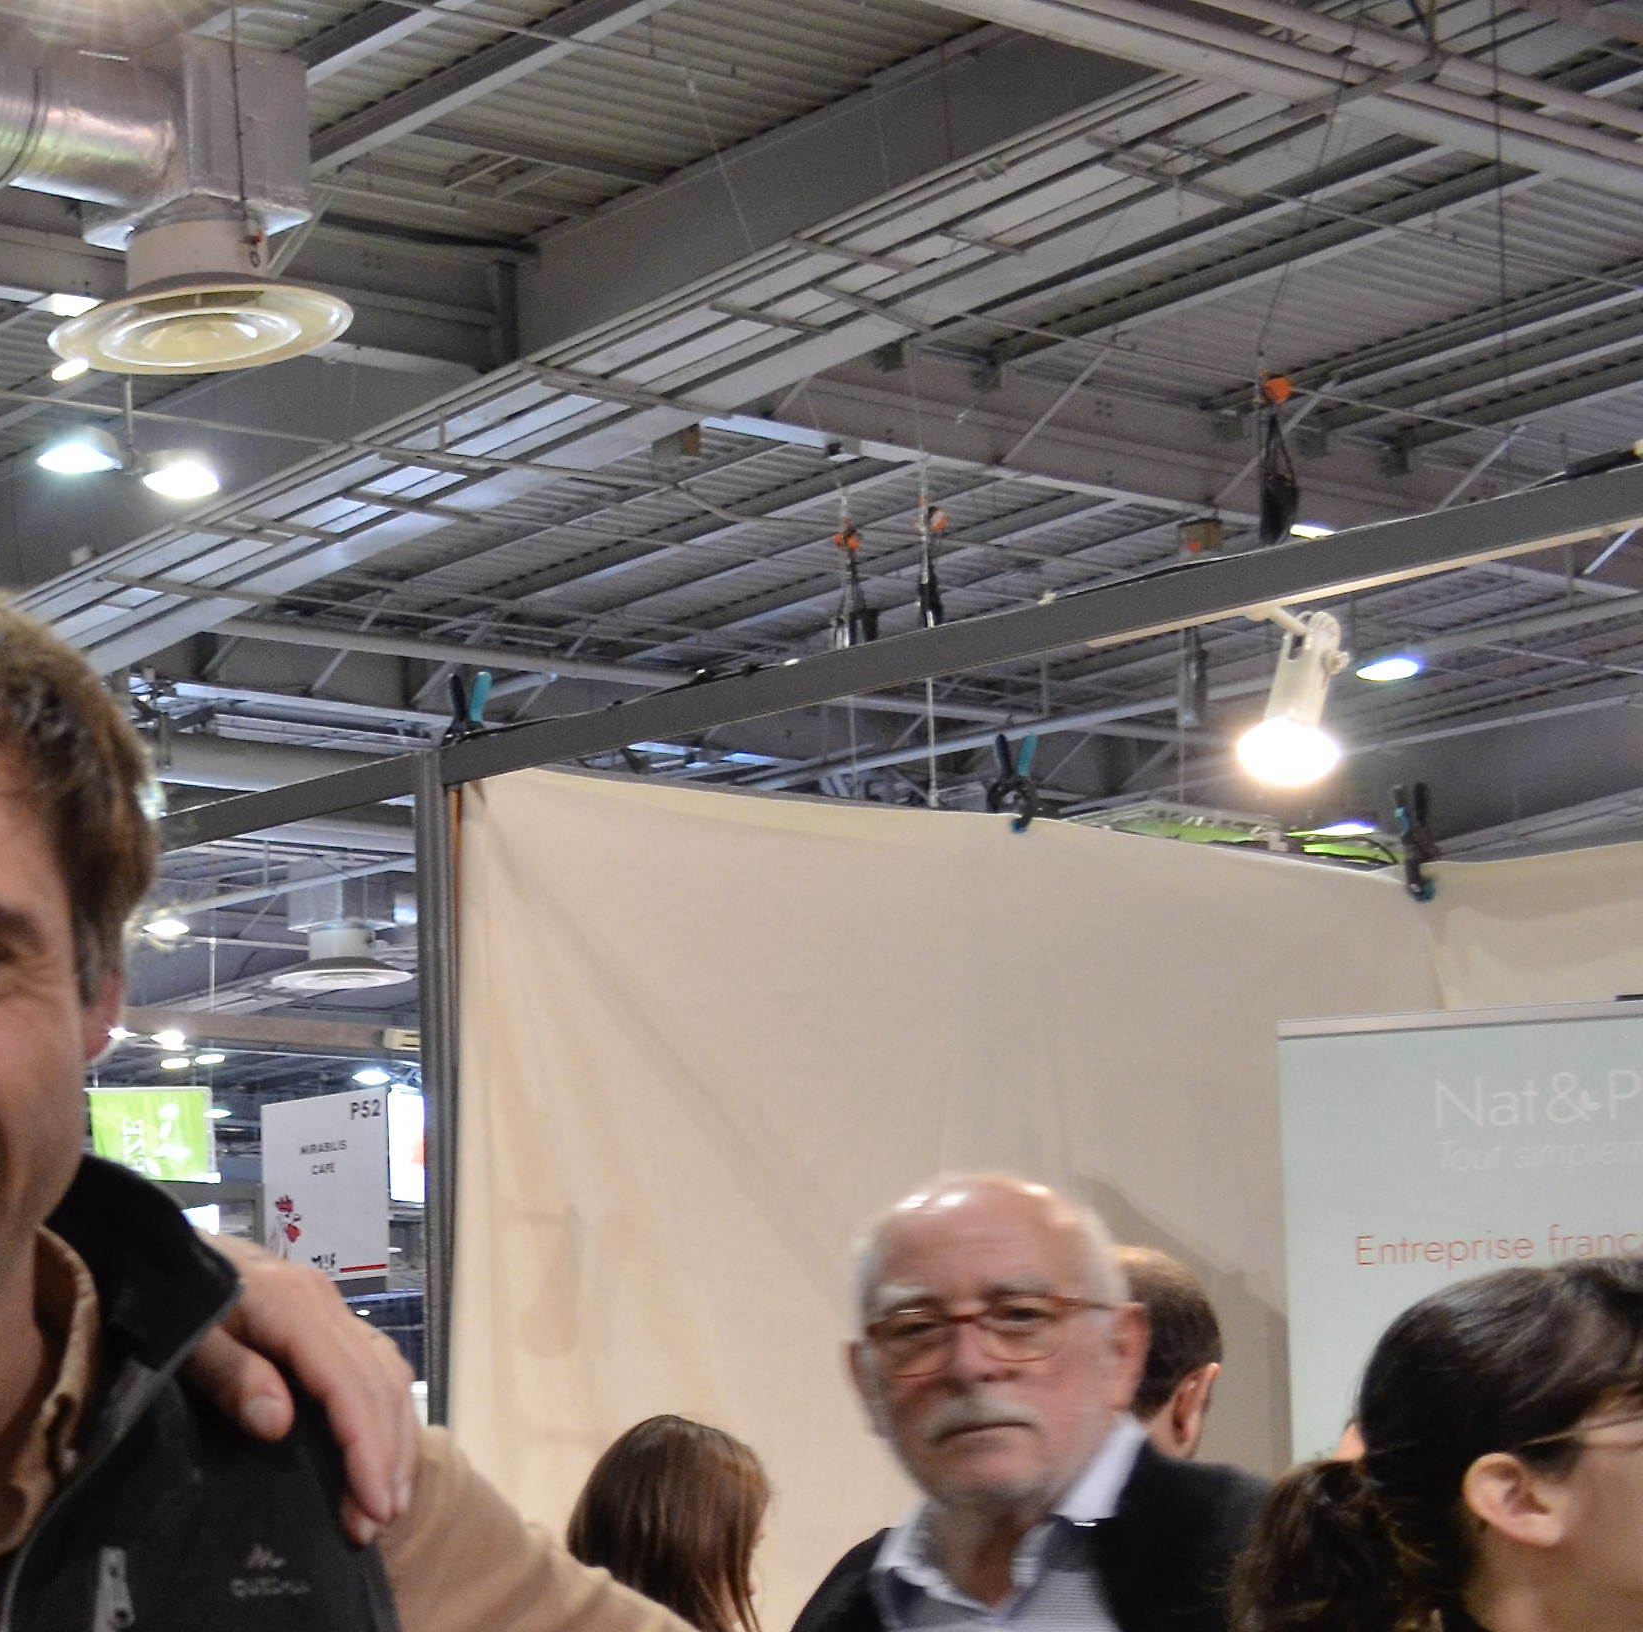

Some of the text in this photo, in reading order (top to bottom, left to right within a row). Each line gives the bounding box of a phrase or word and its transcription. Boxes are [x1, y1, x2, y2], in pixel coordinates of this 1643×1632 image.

[349, 1099, 381, 1121] P52
[299, 1139, 348, 1155] MIRABILIS
[1354, 1229, 1534, 1269] Entreprise
